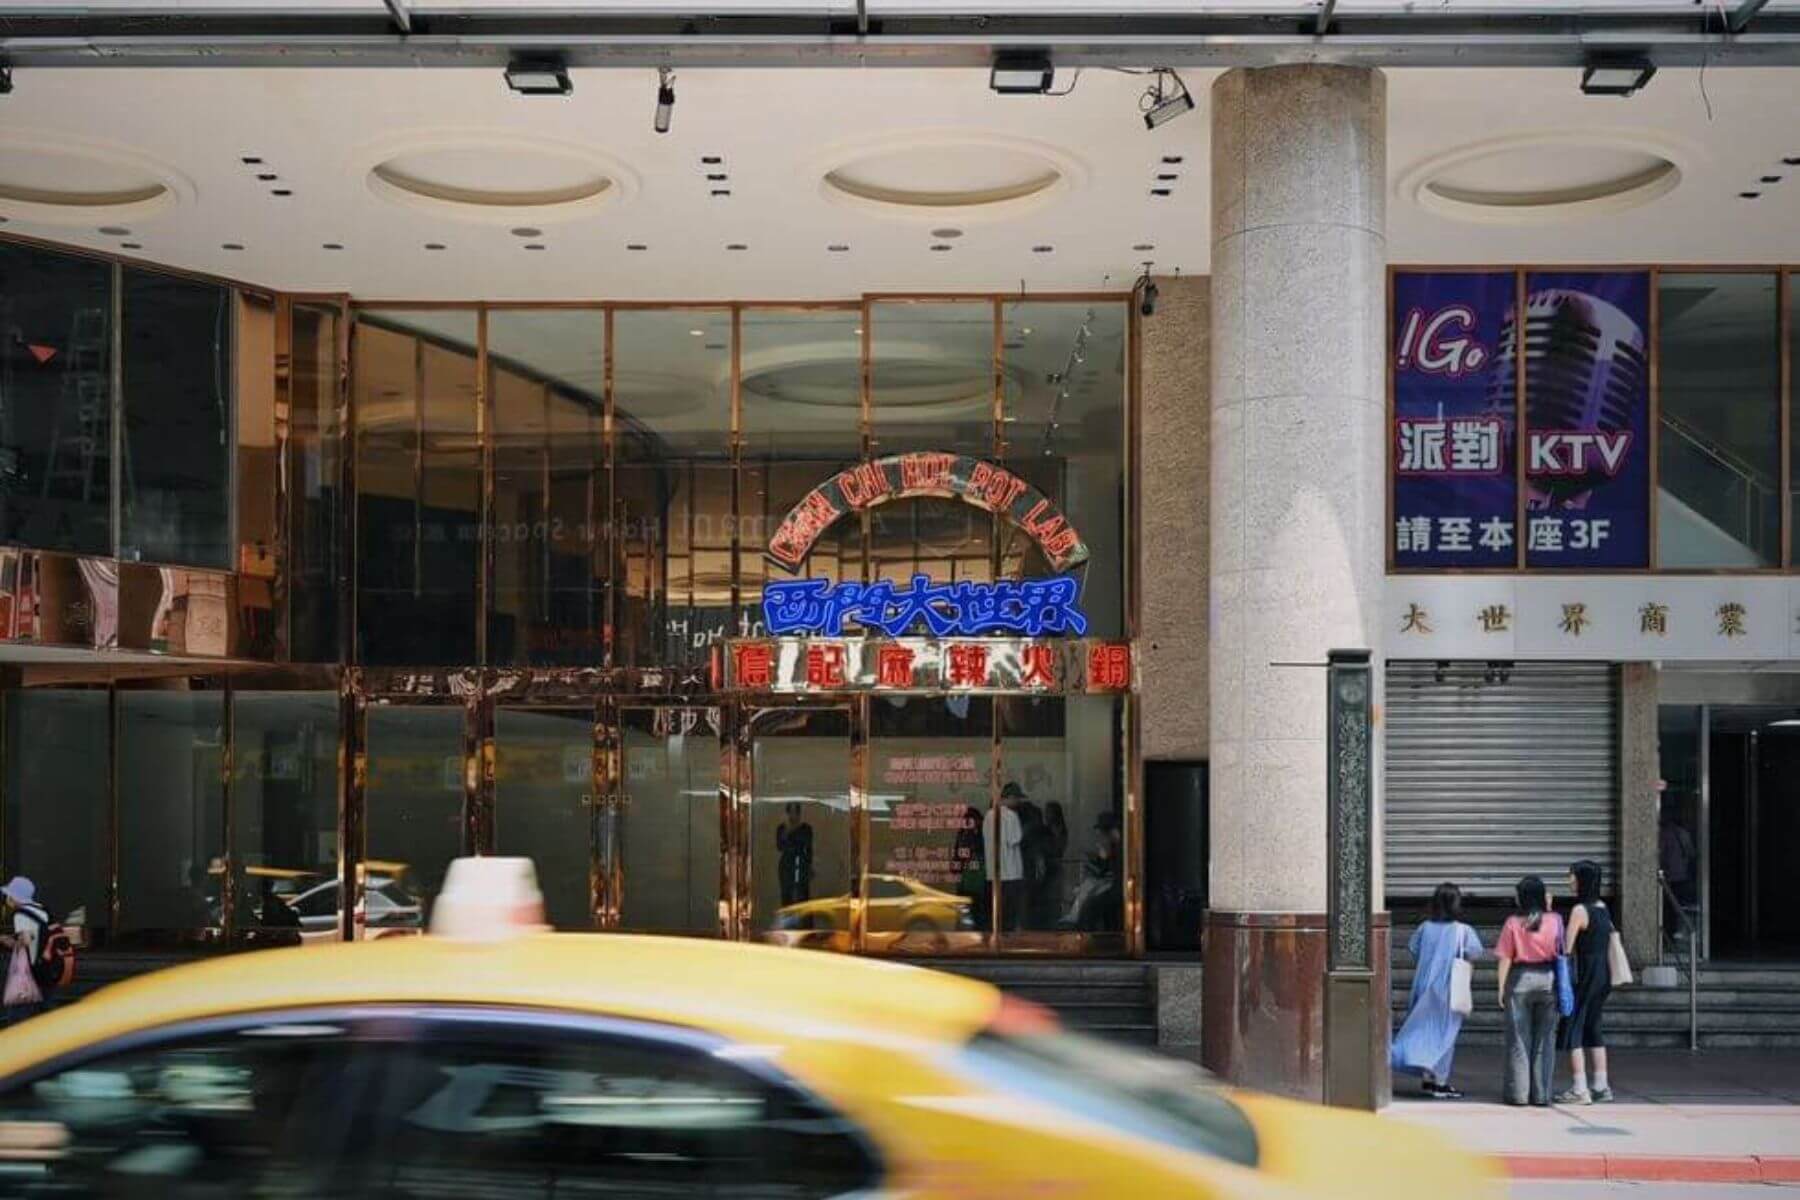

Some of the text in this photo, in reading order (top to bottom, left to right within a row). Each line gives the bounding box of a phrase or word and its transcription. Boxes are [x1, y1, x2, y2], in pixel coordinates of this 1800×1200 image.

[1398, 421, 1628, 470] 派對 KTV
[838, 459, 889, 509] CHI
[902, 453, 957, 489] HOT
[968, 461, 1028, 511] POT
[1022, 498, 1078, 559] LAB
[763, 573, 1087, 636] 西門大世界
[1400, 602, 1800, 638] 大世界商業
